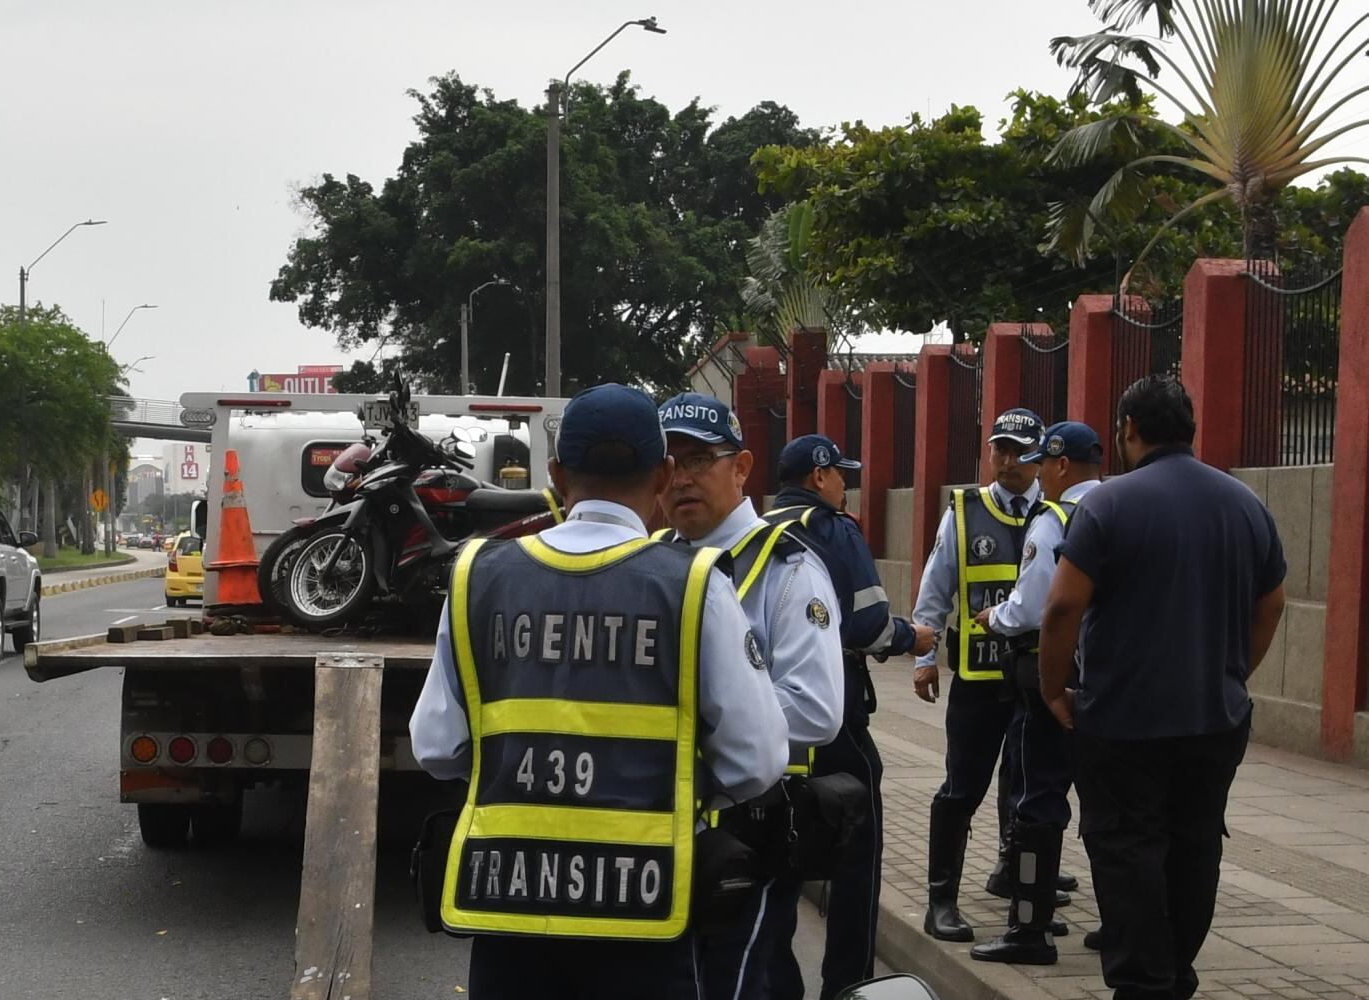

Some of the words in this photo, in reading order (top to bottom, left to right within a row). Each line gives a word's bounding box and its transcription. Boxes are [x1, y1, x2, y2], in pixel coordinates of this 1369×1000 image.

[658, 404, 719, 424] RANSITO
[182, 464, 198, 478] 14
[494, 613, 658, 667] AGENTE
[516, 746, 594, 796] 439
[469, 850, 661, 905] TRANSITO
